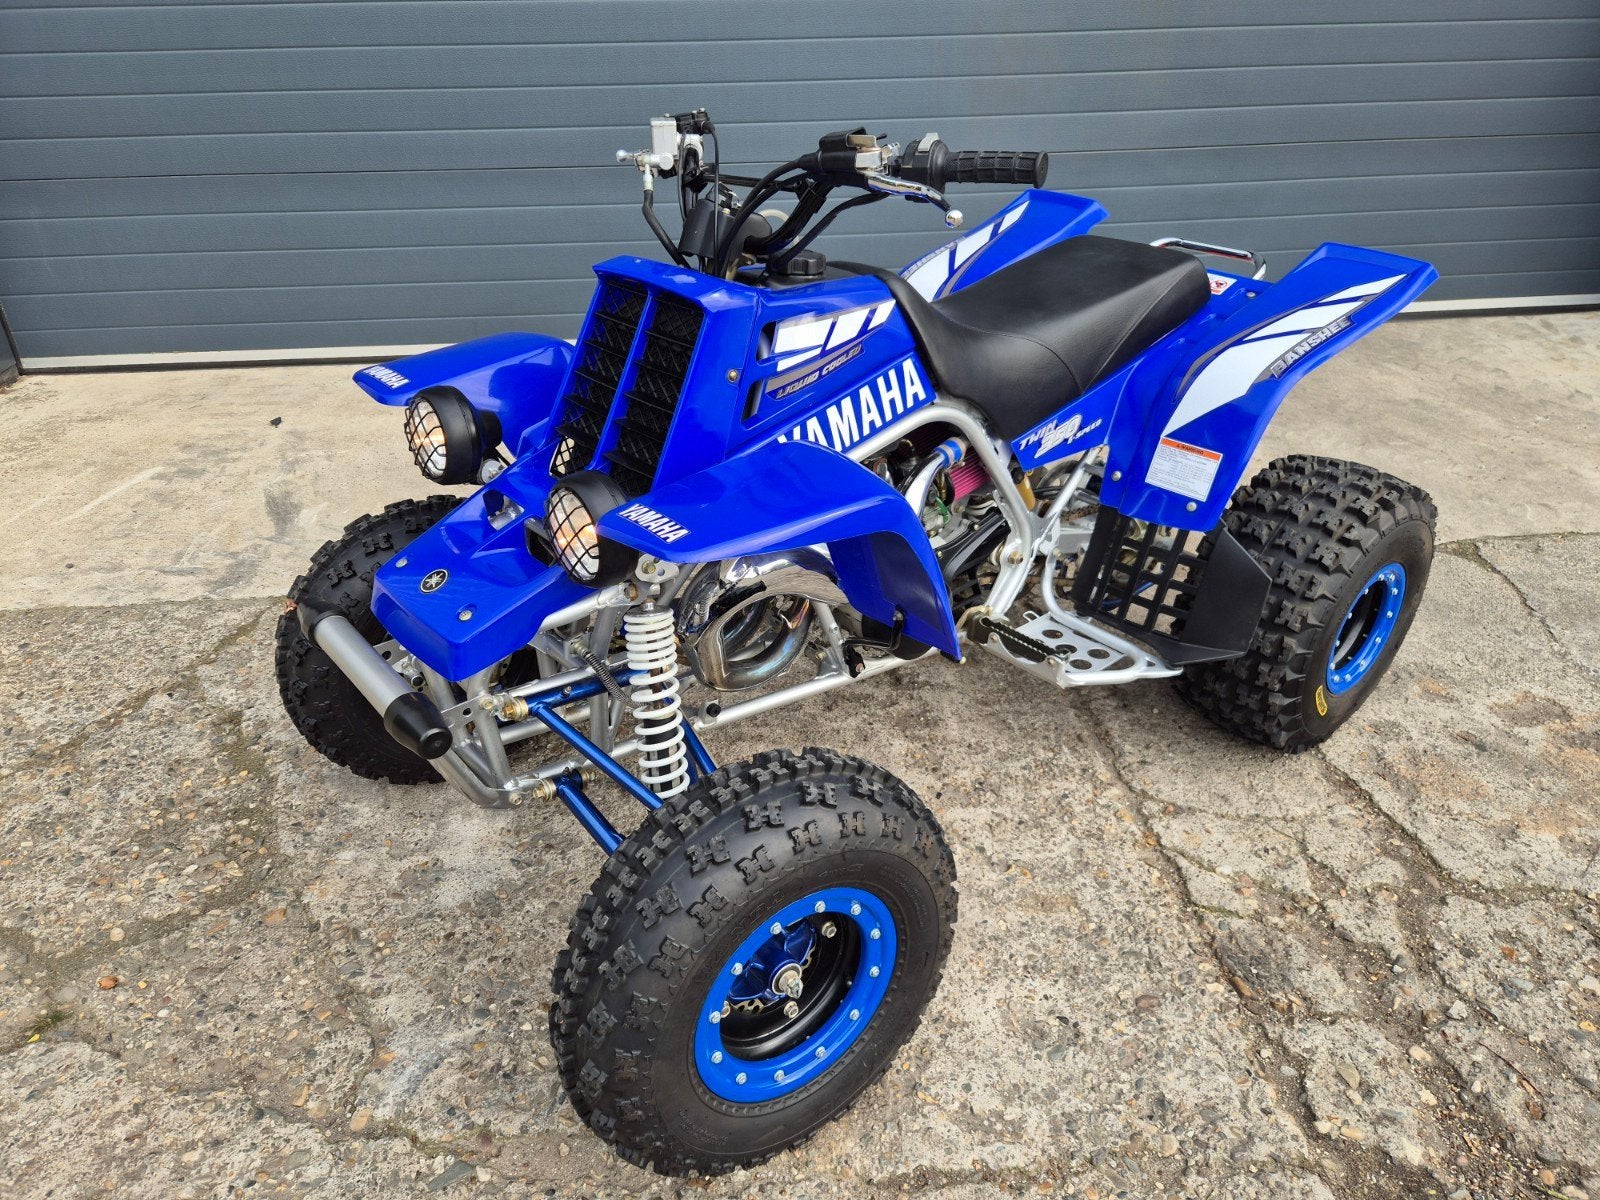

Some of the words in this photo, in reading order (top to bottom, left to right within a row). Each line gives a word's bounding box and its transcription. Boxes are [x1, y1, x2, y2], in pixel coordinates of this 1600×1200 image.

[1270, 315, 1352, 379] BANSHEE
[363, 365, 410, 390] YAMAHA
[775, 371, 819, 400] LIQUID
[821, 344, 862, 376] COOLED
[1019, 419, 1058, 451] TWIN
[1182, 444, 1204, 456] WARNING
[618, 503, 690, 543] YAMAHA
